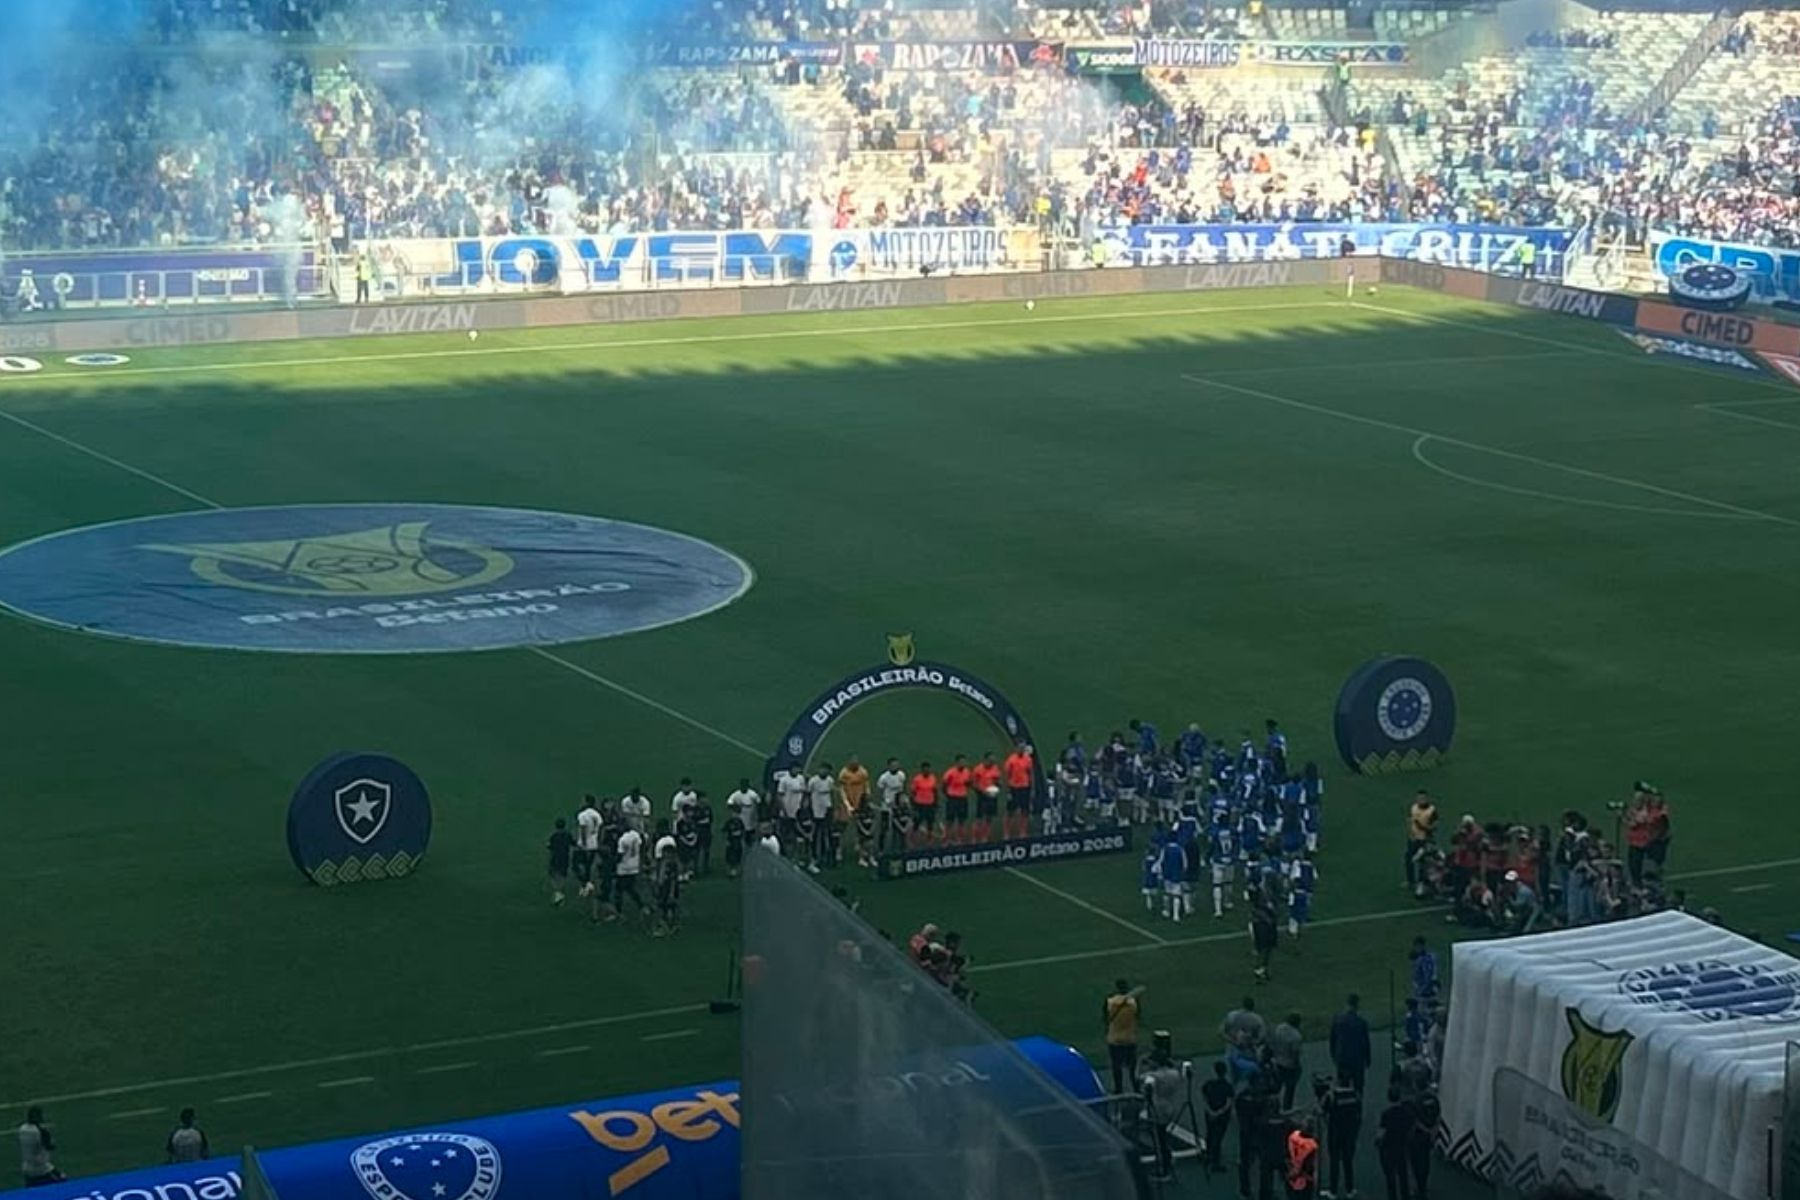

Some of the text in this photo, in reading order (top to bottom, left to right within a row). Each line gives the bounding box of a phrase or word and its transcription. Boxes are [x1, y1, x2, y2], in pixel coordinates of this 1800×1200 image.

[1135, 41, 1240, 66] MOTOZEIROS
[1275, 44, 1384, 62] RASTA
[422, 235, 813, 292] JOVEM
[868, 230, 1009, 269] MOTOZEIROS
[1380, 228, 1530, 277] CRUZ
[1184, 262, 1290, 289] LAVITAN
[787, 282, 901, 310] LAVITAN
[1517, 286, 1605, 319] LAVITAN
[125, 317, 230, 346] CIMED
[350, 305, 477, 333] LAVITAN
[1680, 311, 1755, 346] CIMED
[811, 665, 944, 726] BRASILEIRÃO
[905, 843, 1026, 874] BRASILEIRÃO
[1082, 835, 1125, 852] 2026
[568, 1091, 741, 1152] bet
